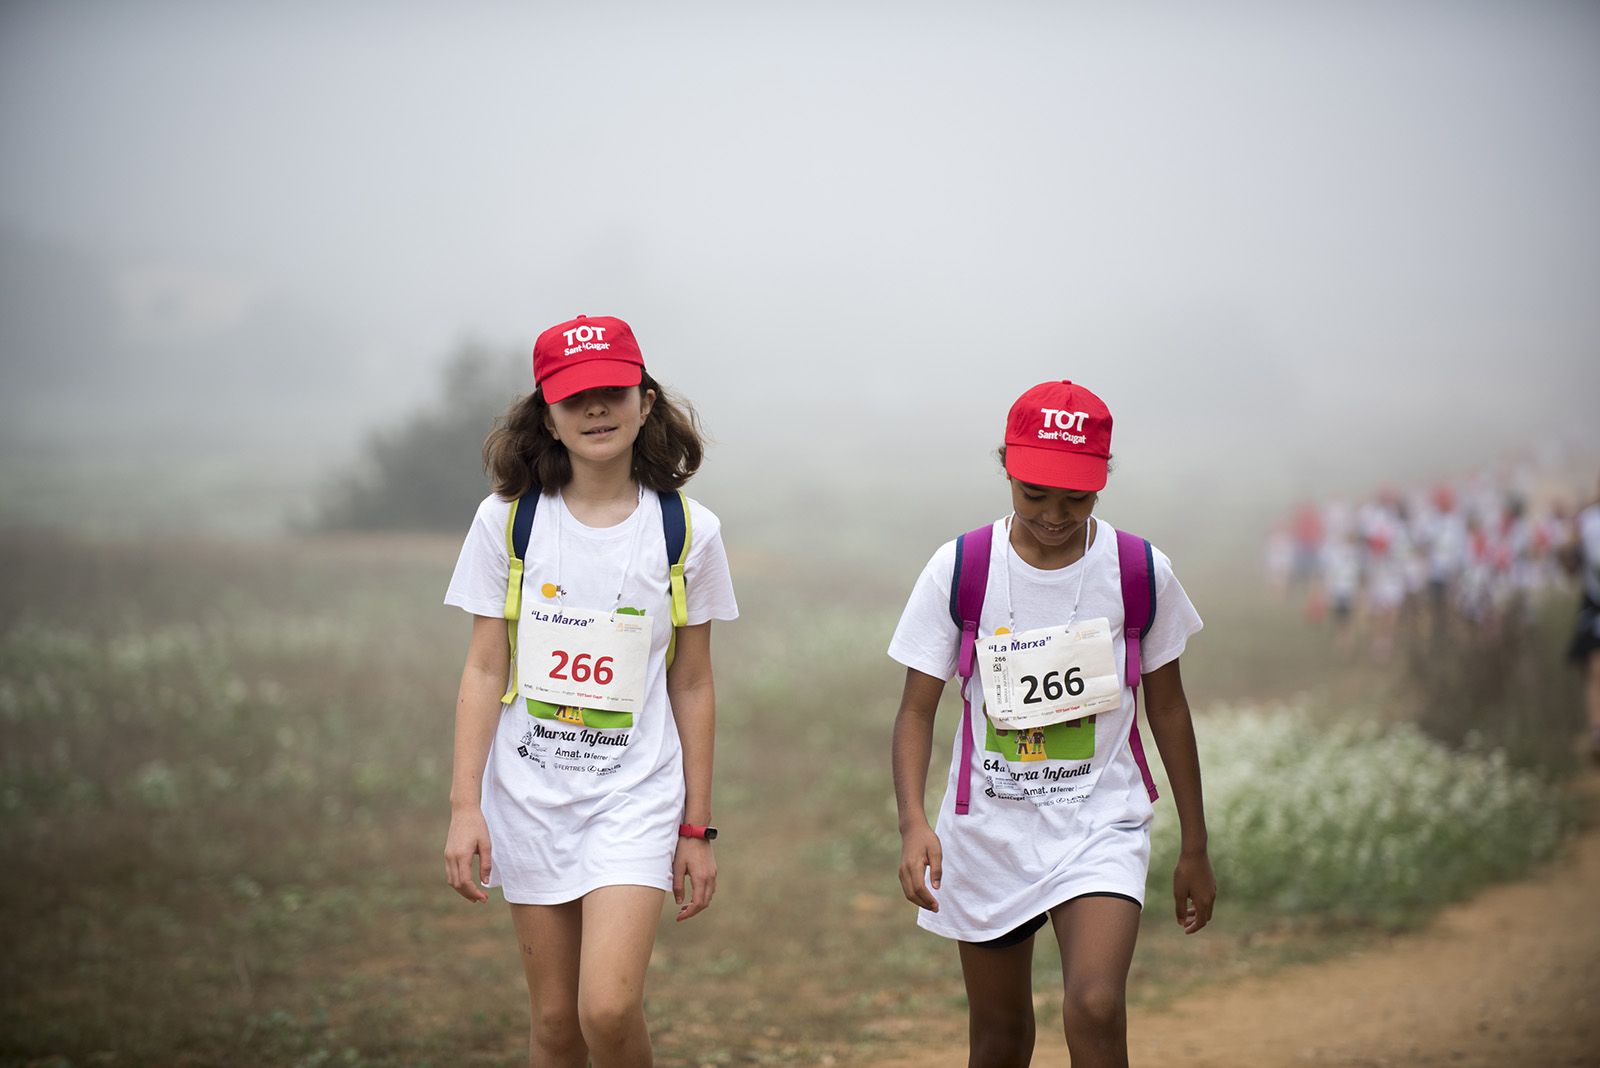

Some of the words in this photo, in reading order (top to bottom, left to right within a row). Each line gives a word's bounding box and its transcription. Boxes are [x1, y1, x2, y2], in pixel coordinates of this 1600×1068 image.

[562, 325, 606, 346] TOT
[564, 344, 583, 356] Sant
[586, 342, 610, 351] Cugat
[1040, 407, 1089, 432] TOT
[1037, 429, 1058, 440] Sant
[1062, 431, 1087, 445] Cugat
[549, 650, 614, 685] 266
[1020, 667, 1085, 704] 266
[533, 724, 577, 741] Marxa
[580, 729, 630, 747] Infantil
[555, 747, 581, 758] Amat.
[1007, 764, 1040, 782] arxa
[1042, 763, 1092, 782] Infantil
